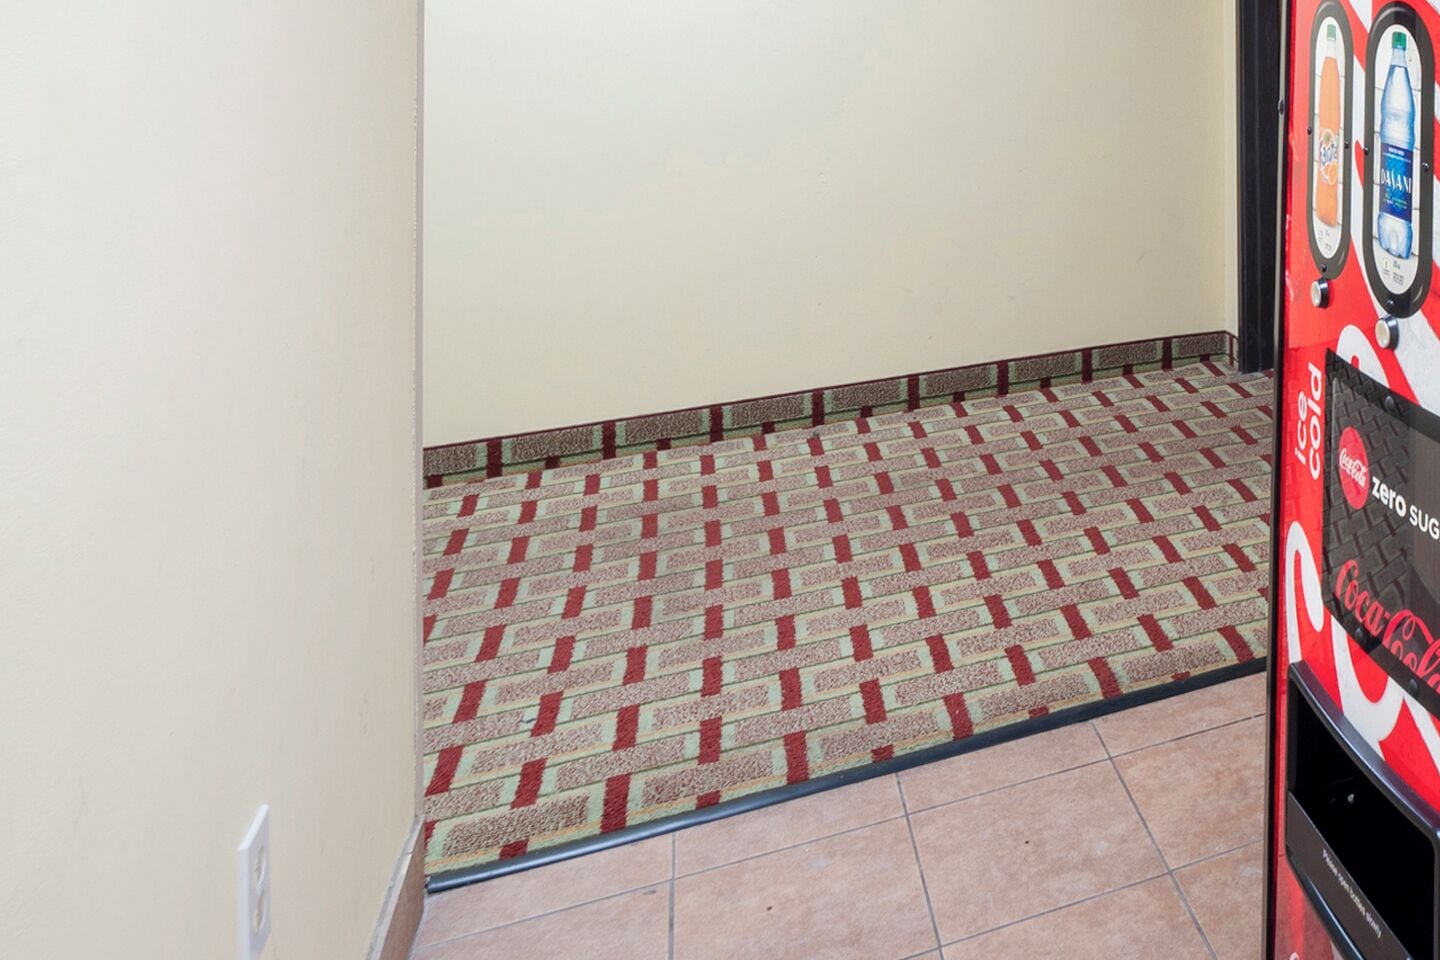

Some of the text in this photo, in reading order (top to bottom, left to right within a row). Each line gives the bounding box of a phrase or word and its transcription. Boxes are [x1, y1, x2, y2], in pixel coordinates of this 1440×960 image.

[1381, 168, 1411, 193] DASANI
[1294, 391, 1307, 465] ice
[1307, 363, 1322, 480] cold
[1337, 447, 1366, 488] Coca-Cola
[1372, 475, 1407, 518] zero
